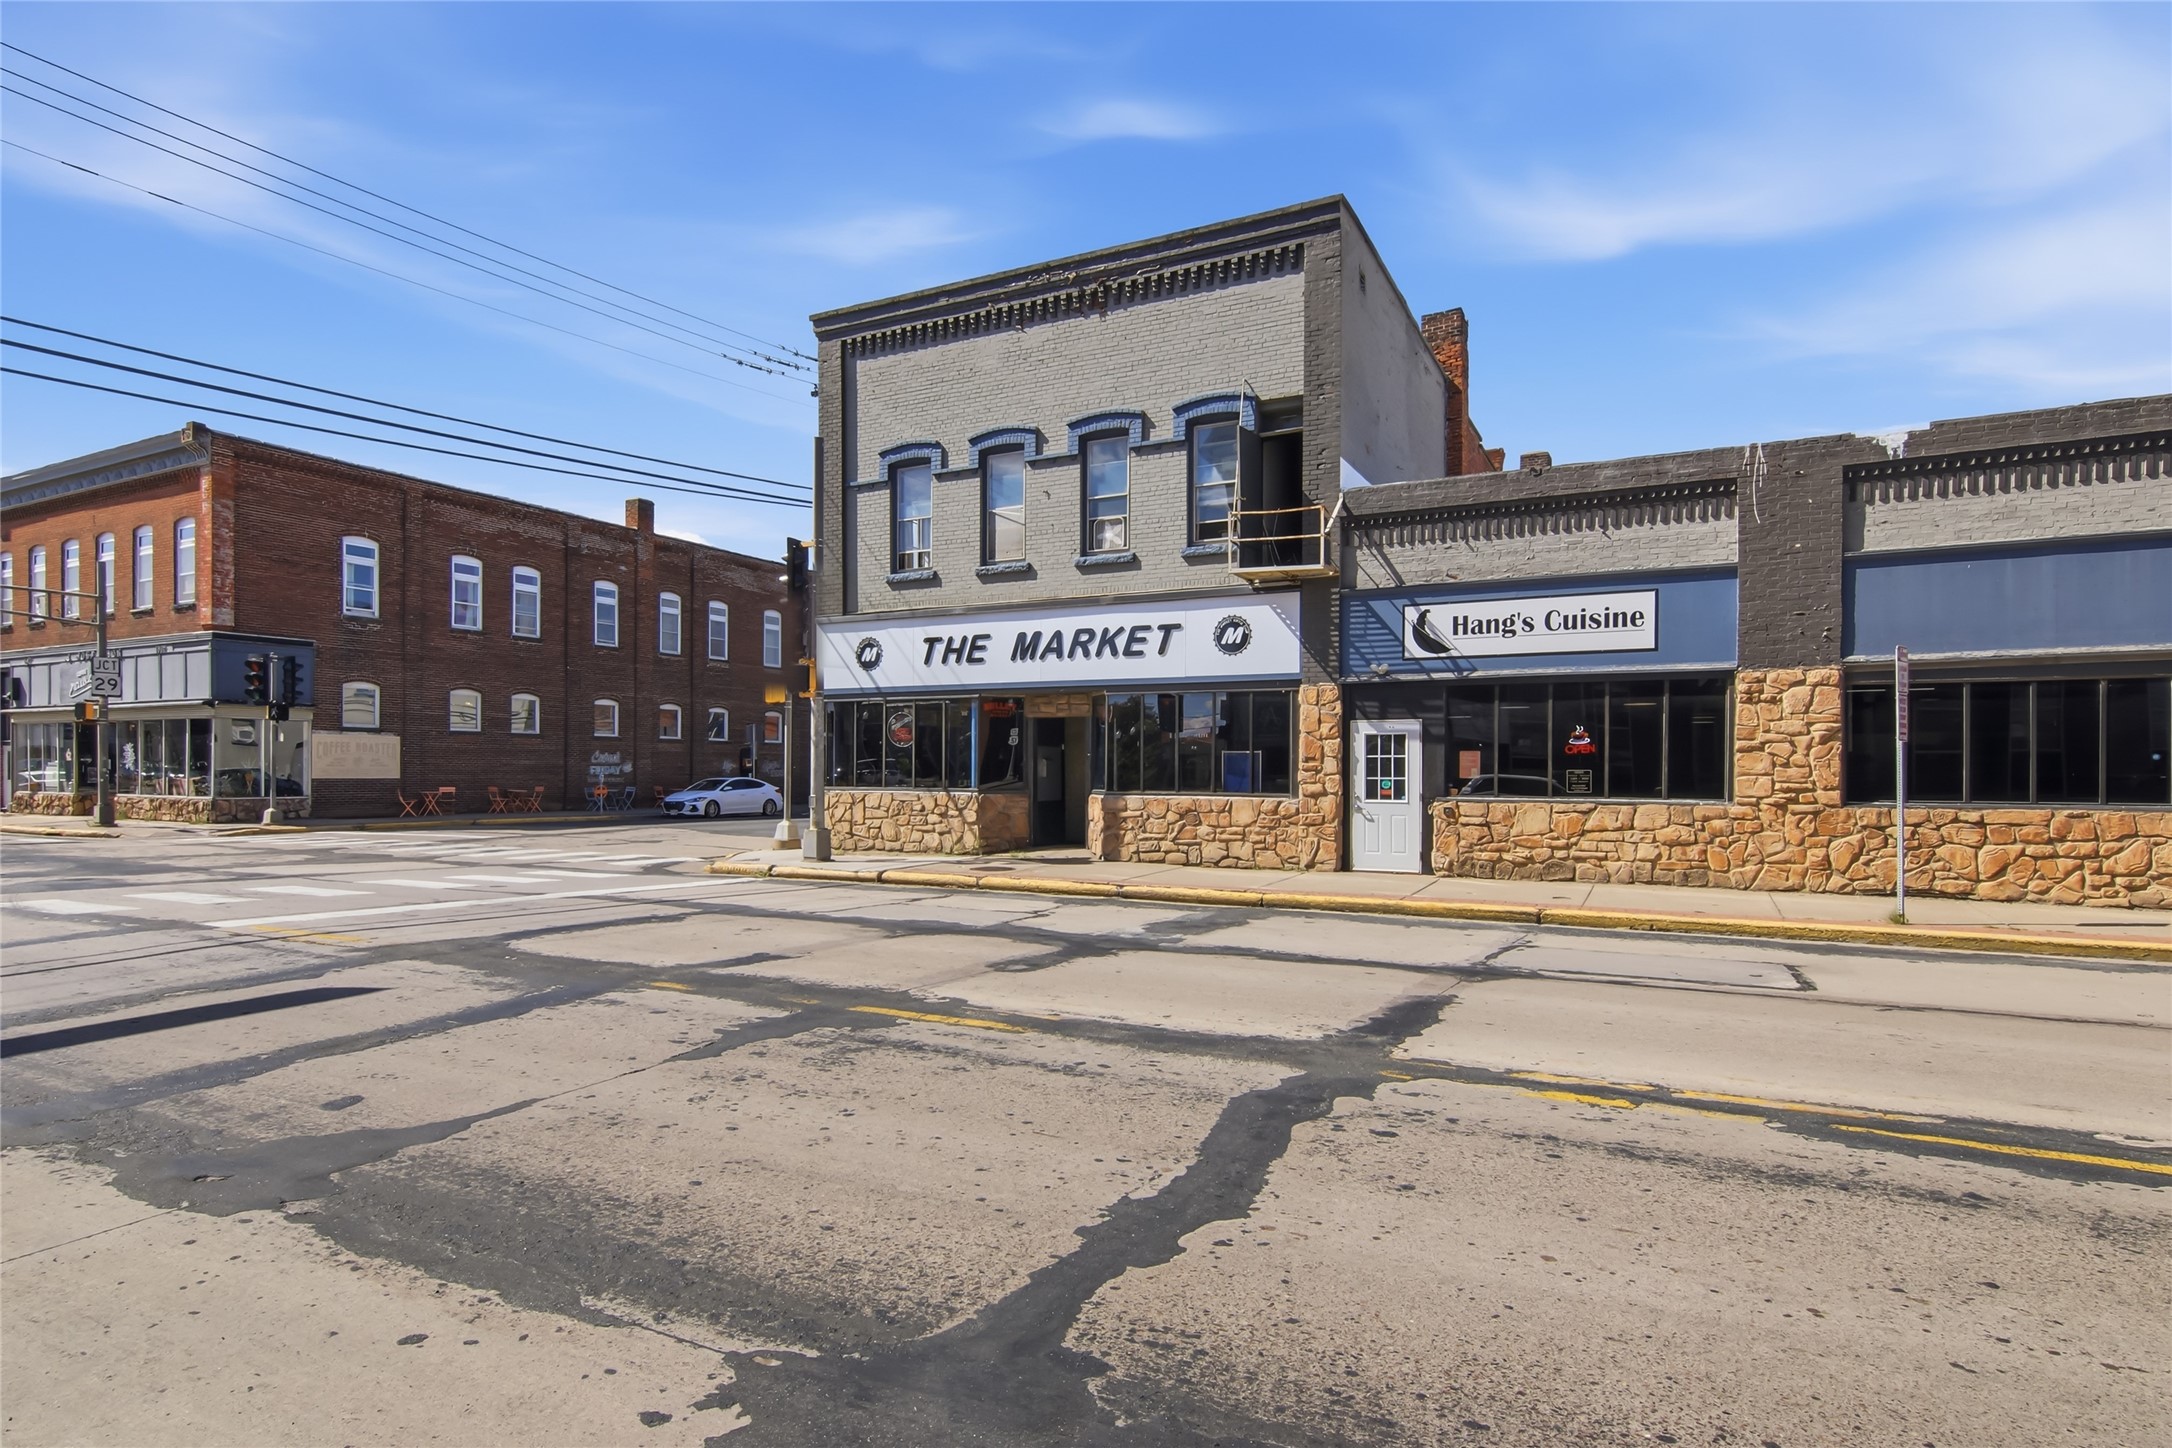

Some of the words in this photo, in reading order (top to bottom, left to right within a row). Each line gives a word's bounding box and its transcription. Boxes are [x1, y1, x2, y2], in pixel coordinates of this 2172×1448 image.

[1452, 612, 1535, 639] Hang's
[1544, 606, 1645, 632] Cuisine
[1220, 627, 1244, 645] M
[923, 633, 992, 666] THE
[1010, 623, 1183, 662] MARKET
[861, 647, 878, 662] M
[95, 660, 118, 670] JCT
[94, 677, 118, 691] 29
[316, 741, 352, 759] COFFEE
[1564, 744, 1596, 754] OPEN
